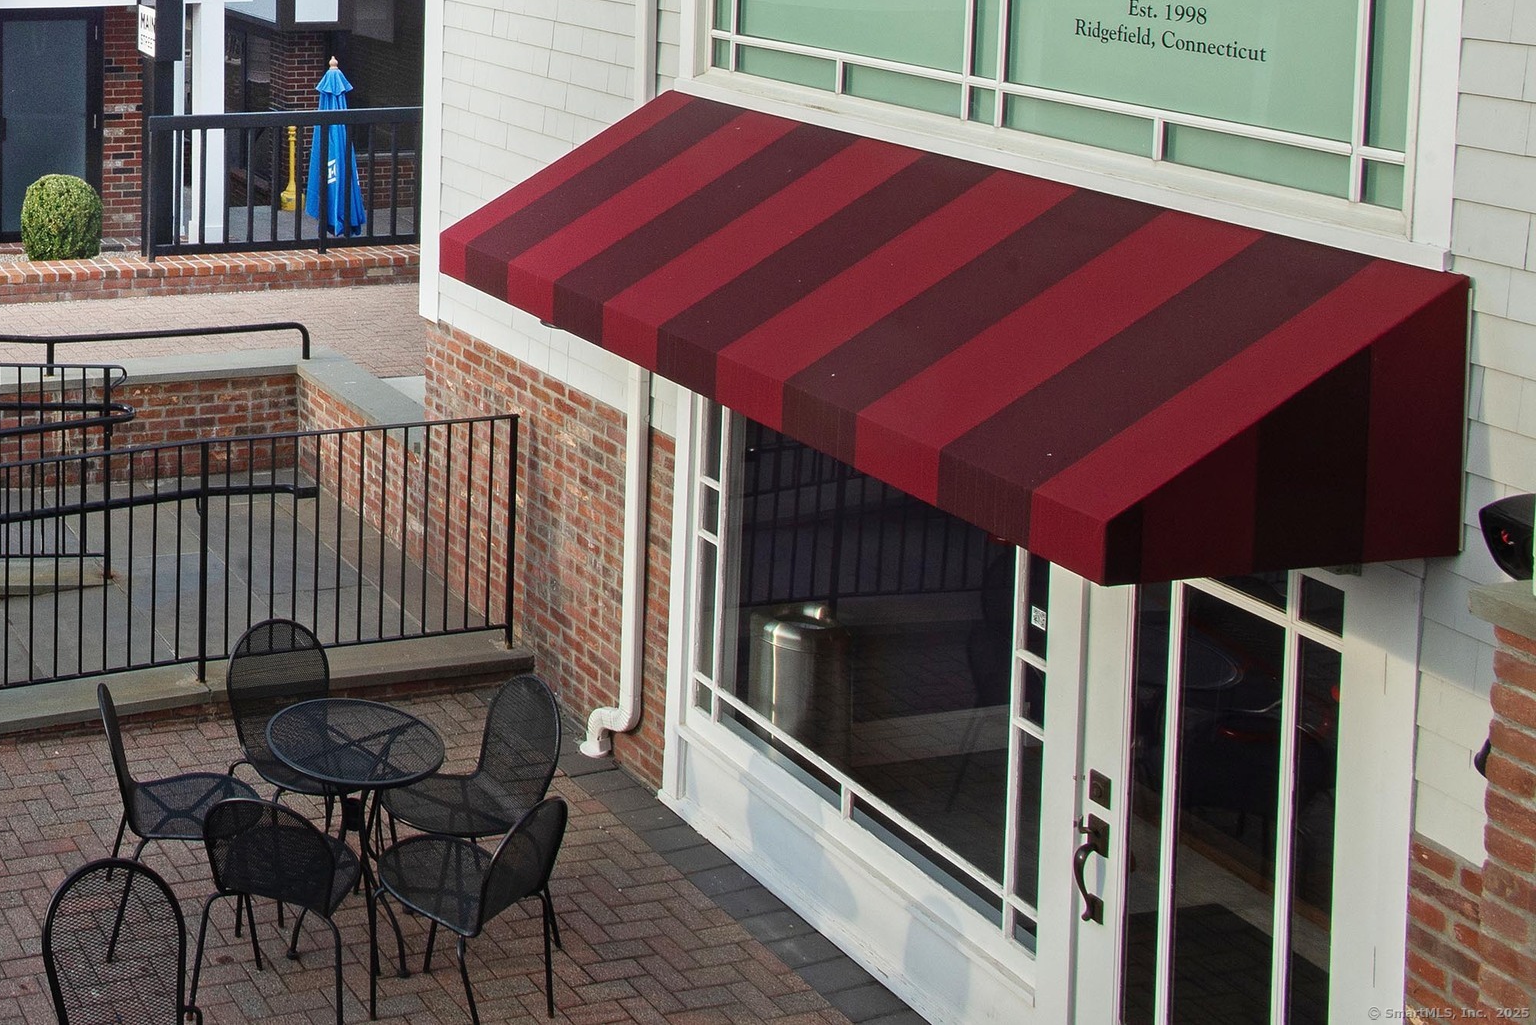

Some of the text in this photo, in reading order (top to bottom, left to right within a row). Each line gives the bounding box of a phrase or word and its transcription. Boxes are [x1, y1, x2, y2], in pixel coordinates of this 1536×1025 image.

[1165, 4, 1207, 25] 1998
[1074, 18, 1267, 62] Ridgefield, Connecticut
